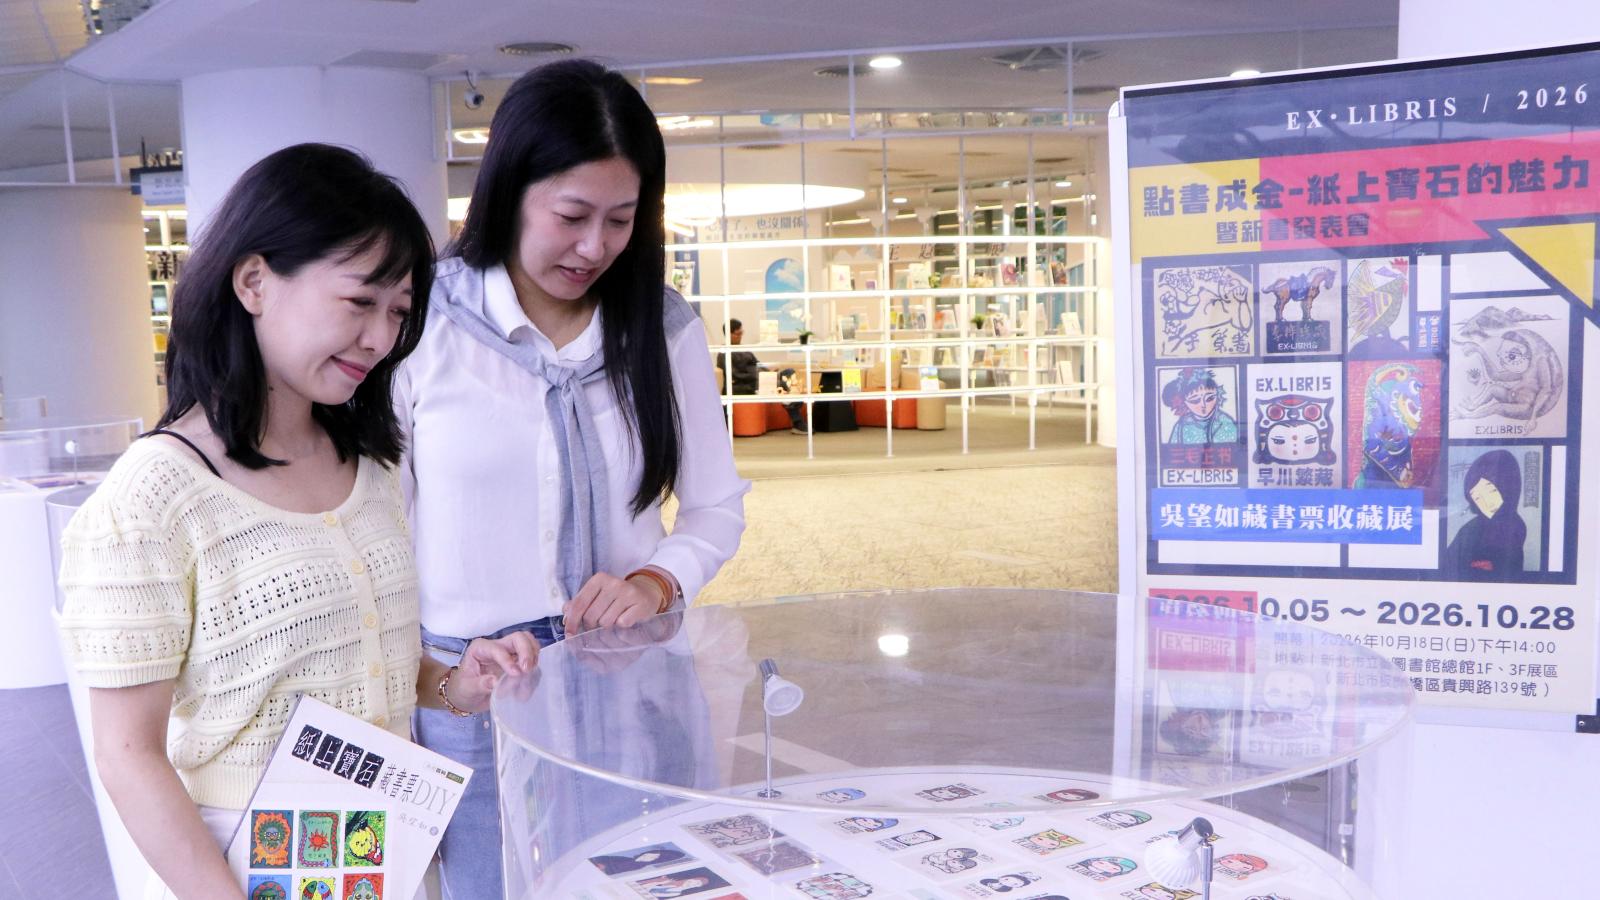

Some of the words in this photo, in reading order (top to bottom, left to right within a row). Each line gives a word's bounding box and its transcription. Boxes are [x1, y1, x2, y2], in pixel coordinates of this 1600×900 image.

[1517, 83, 1589, 111] 2026
[1143, 155, 1590, 218] 點書成金-紙上寶石的魅力
[1216, 213, 1371, 245] 暨新書發表會
[1167, 469, 1234, 484] EX-LIBRIS
[1160, 502, 1415, 532] 吳望如藏書票收藏展
[1155, 594, 1330, 622] 610.05
[1377, 601, 1575, 631] 2026.10.28
[411, 778, 457, 815] DIY
